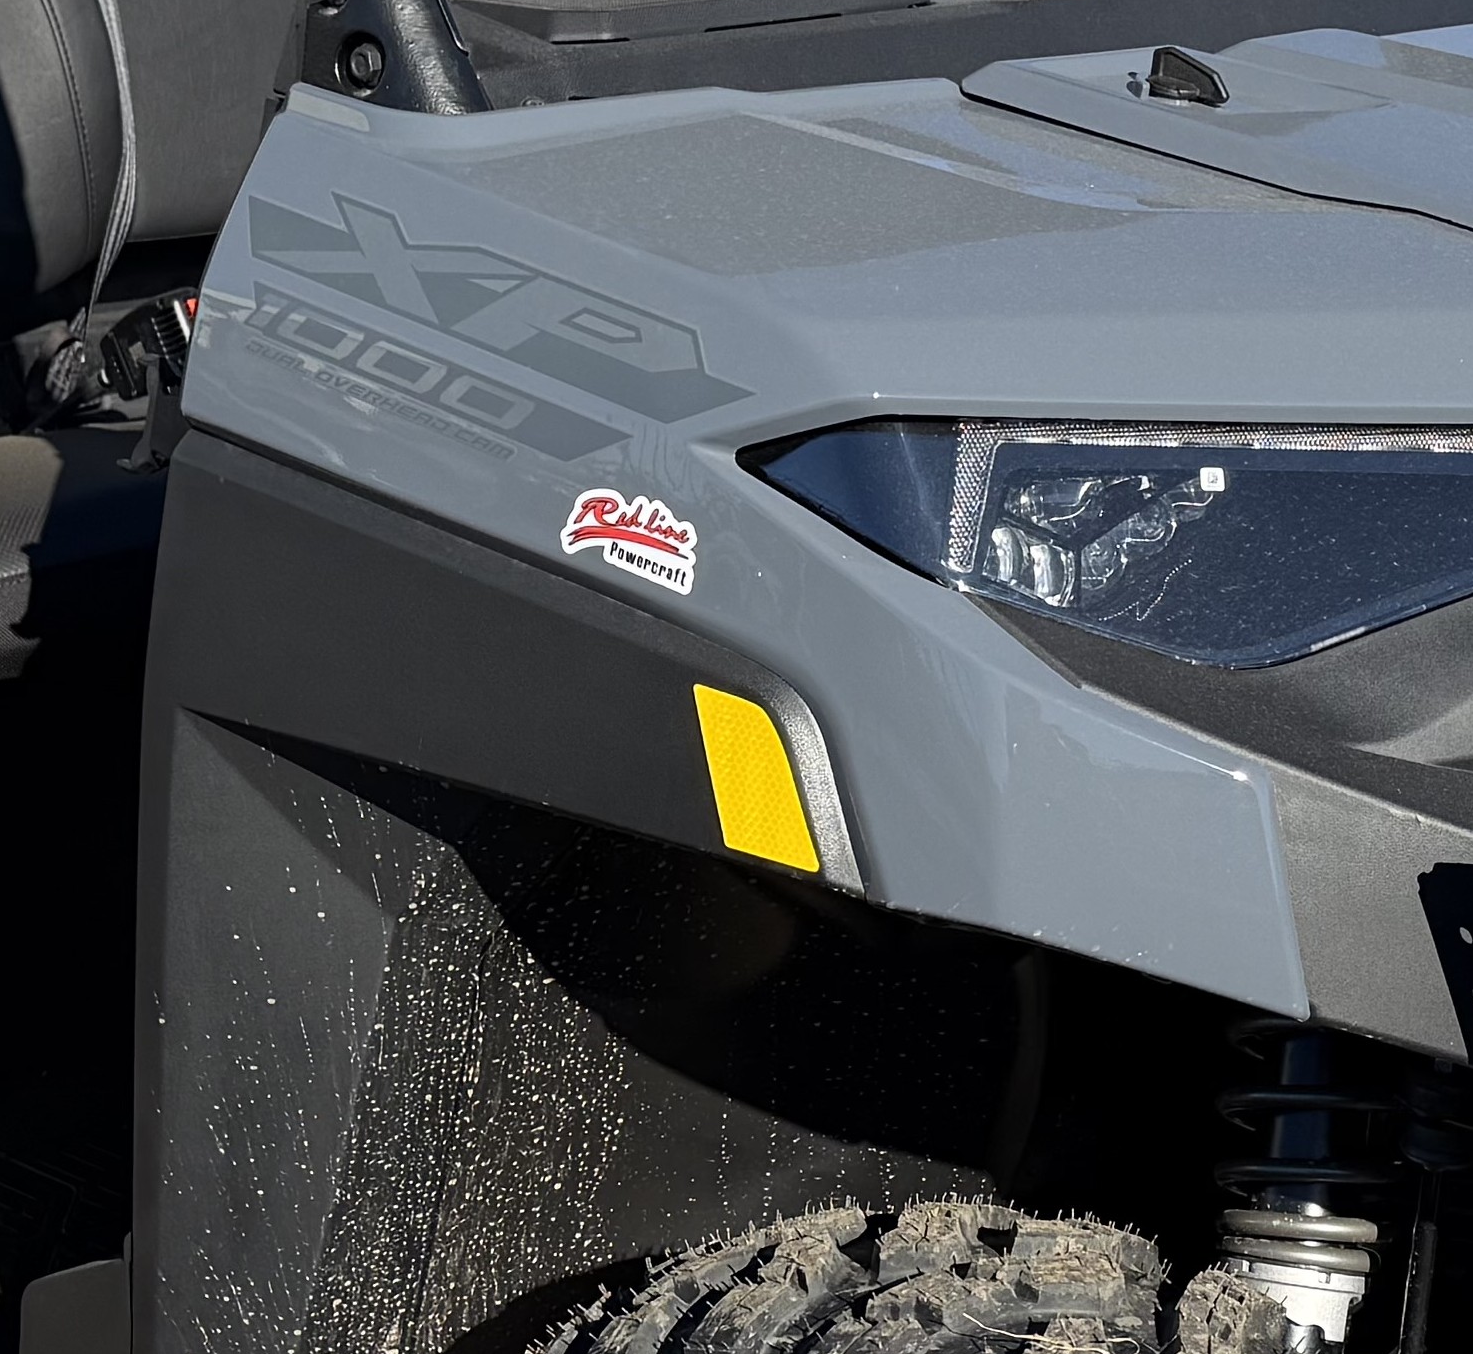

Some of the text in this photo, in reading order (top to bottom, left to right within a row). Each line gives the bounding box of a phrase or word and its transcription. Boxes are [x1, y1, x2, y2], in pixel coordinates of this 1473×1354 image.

[250, 190, 708, 374] XP
[243, 293, 535, 431] 1000
[245, 339, 517, 460] DUAL OVERHEAD CAM
[609, 541, 688, 587] Powercraft
